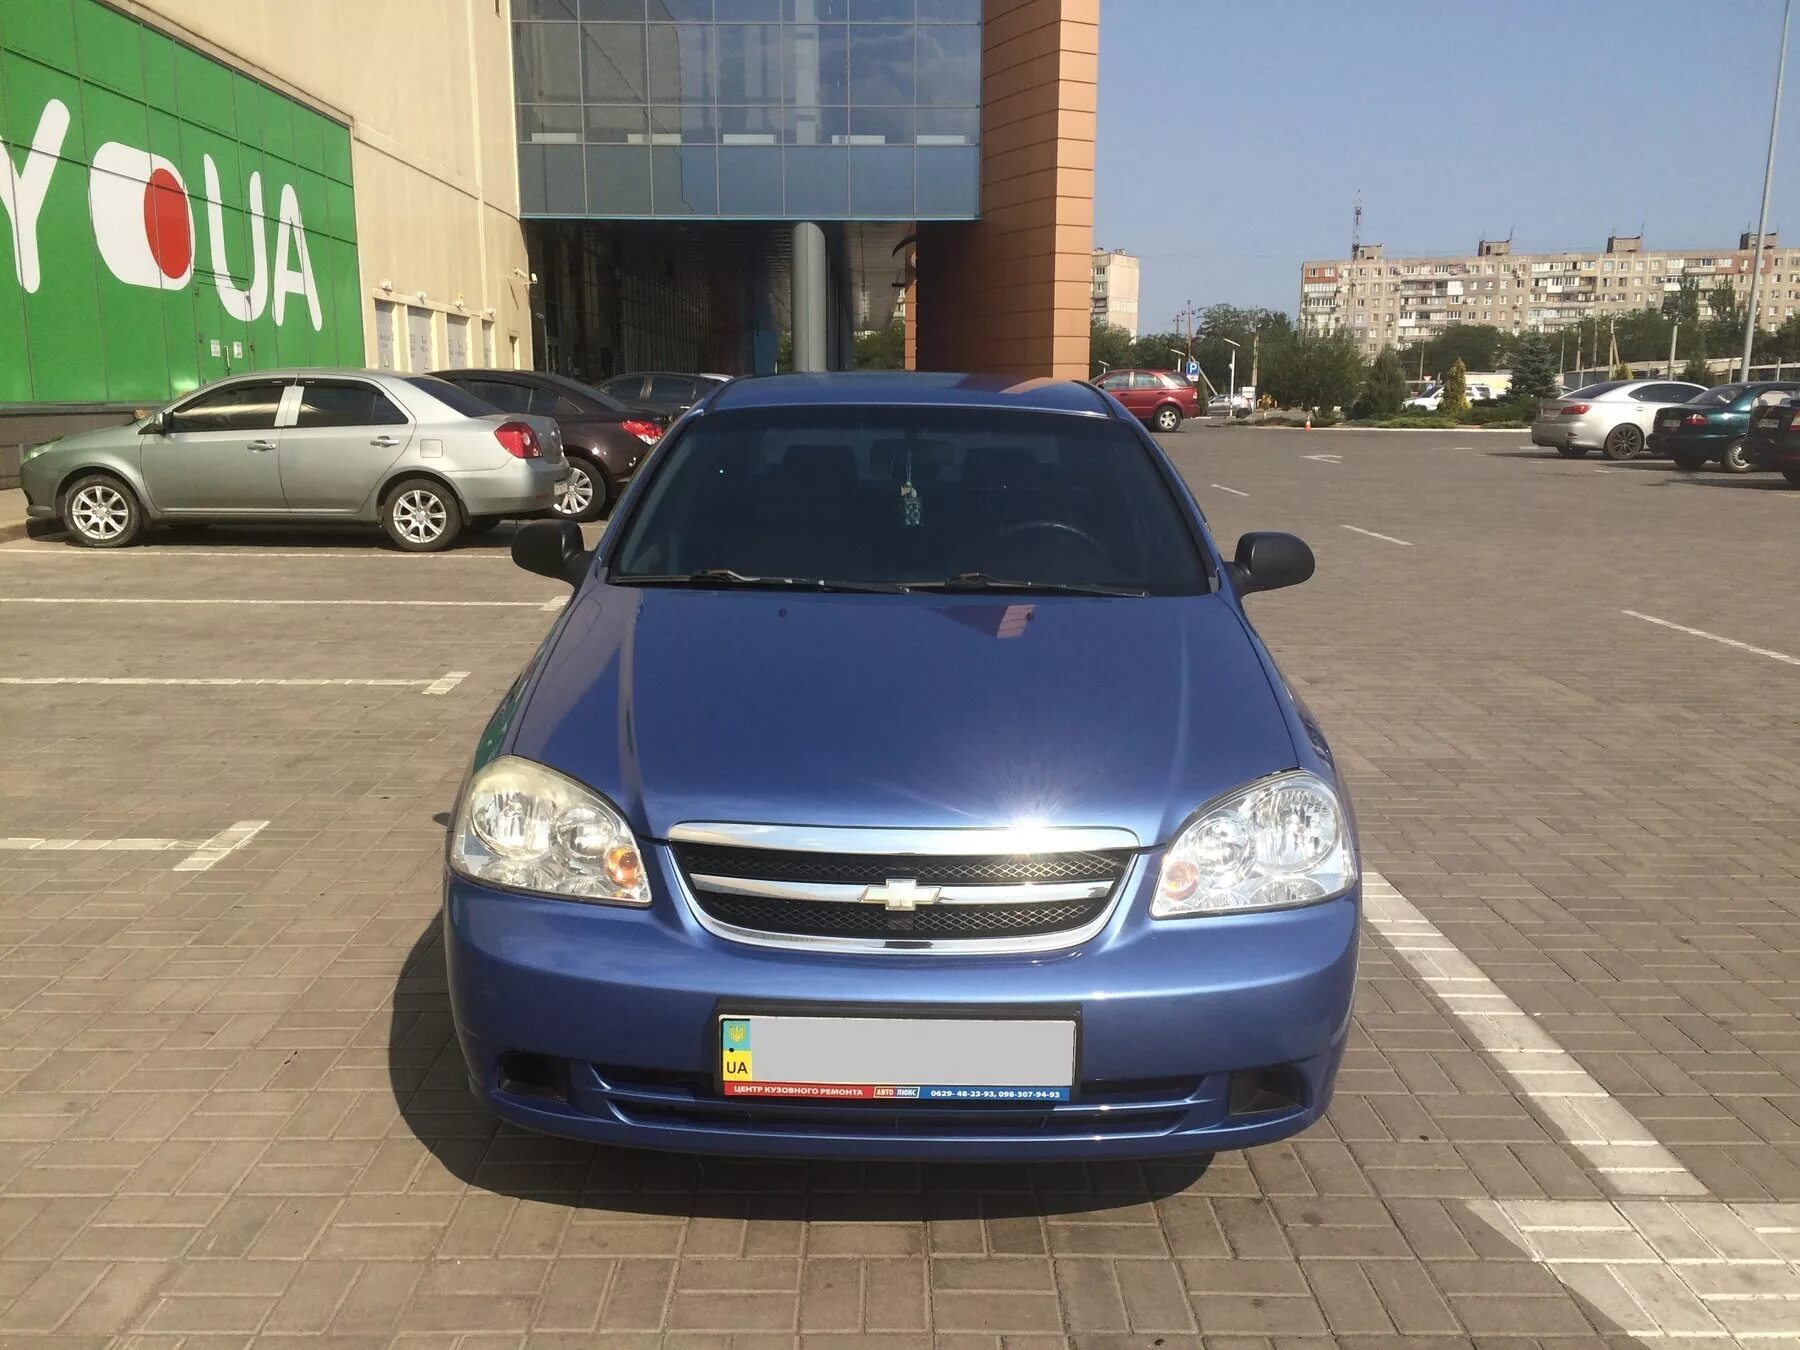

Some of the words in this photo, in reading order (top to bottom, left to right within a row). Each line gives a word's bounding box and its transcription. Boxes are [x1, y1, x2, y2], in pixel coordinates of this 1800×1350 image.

[1190, 363, 1198, 374] P
[726, 1061, 748, 1075] UA
[733, 1085, 763, 1093] ЦЕНТР
[764, 1086, 819, 1095] КУЗОВНОГО
[820, 1087, 863, 1096] РЕМОНТА
[998, 1090, 1060, 1098] 098-307-94-93
